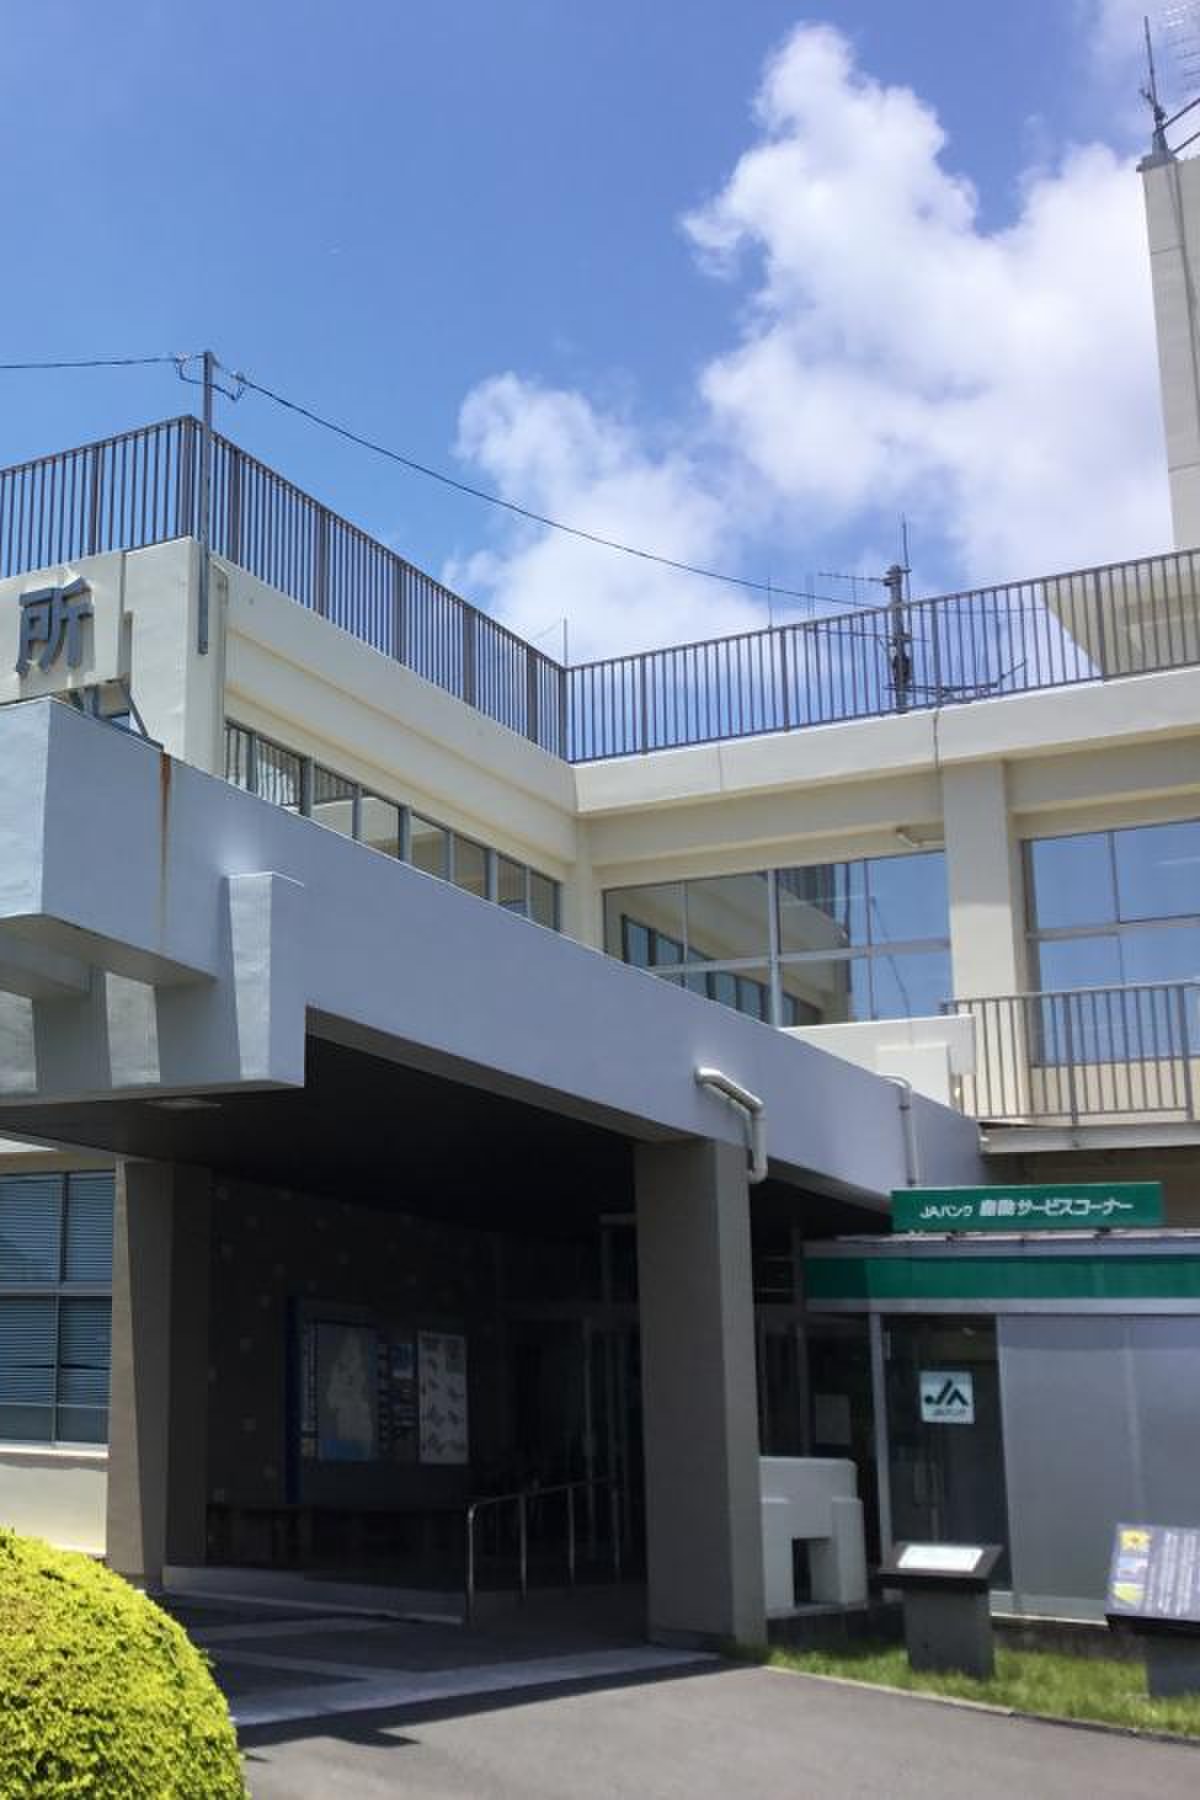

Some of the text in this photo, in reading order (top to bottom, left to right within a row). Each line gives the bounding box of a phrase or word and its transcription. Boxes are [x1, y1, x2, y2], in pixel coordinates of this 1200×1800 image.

[919, 1205, 974, 1219] JAバンク
[924, 1378, 969, 1407] JA
